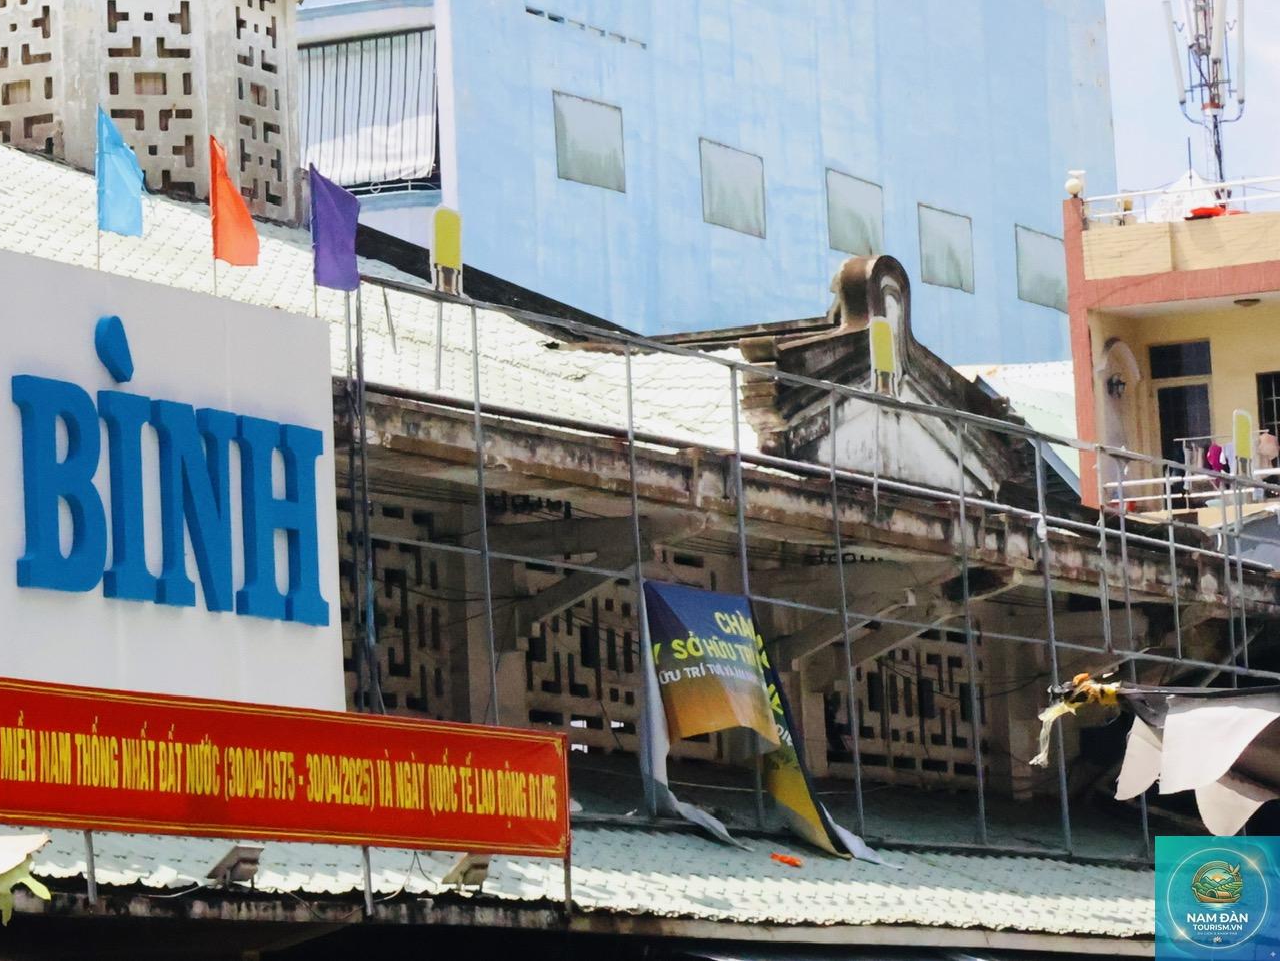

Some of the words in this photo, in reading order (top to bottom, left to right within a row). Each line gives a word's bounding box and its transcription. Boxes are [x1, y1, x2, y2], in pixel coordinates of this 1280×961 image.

[10, 315, 330, 627] BÌNH
[0, 710, 36, 783] MIỀN
[39, 730, 71, 785] NAM
[74, 715, 119, 789] THỐNG
[122, 720, 156, 791] NHẤT
[158, 723, 183, 793] ĐẤT
[185, 733, 220, 797] NƯỚC
[376, 748, 393, 808] VÀ
[395, 751, 425, 811] NGÀY
[427, 747, 458, 816] QUỐC
[459, 751, 474, 814] TẾ
[474, 767, 496, 816] LAO
[496, 759, 527, 829] ĐỘNG
[528, 772, 557, 822] 01/05
